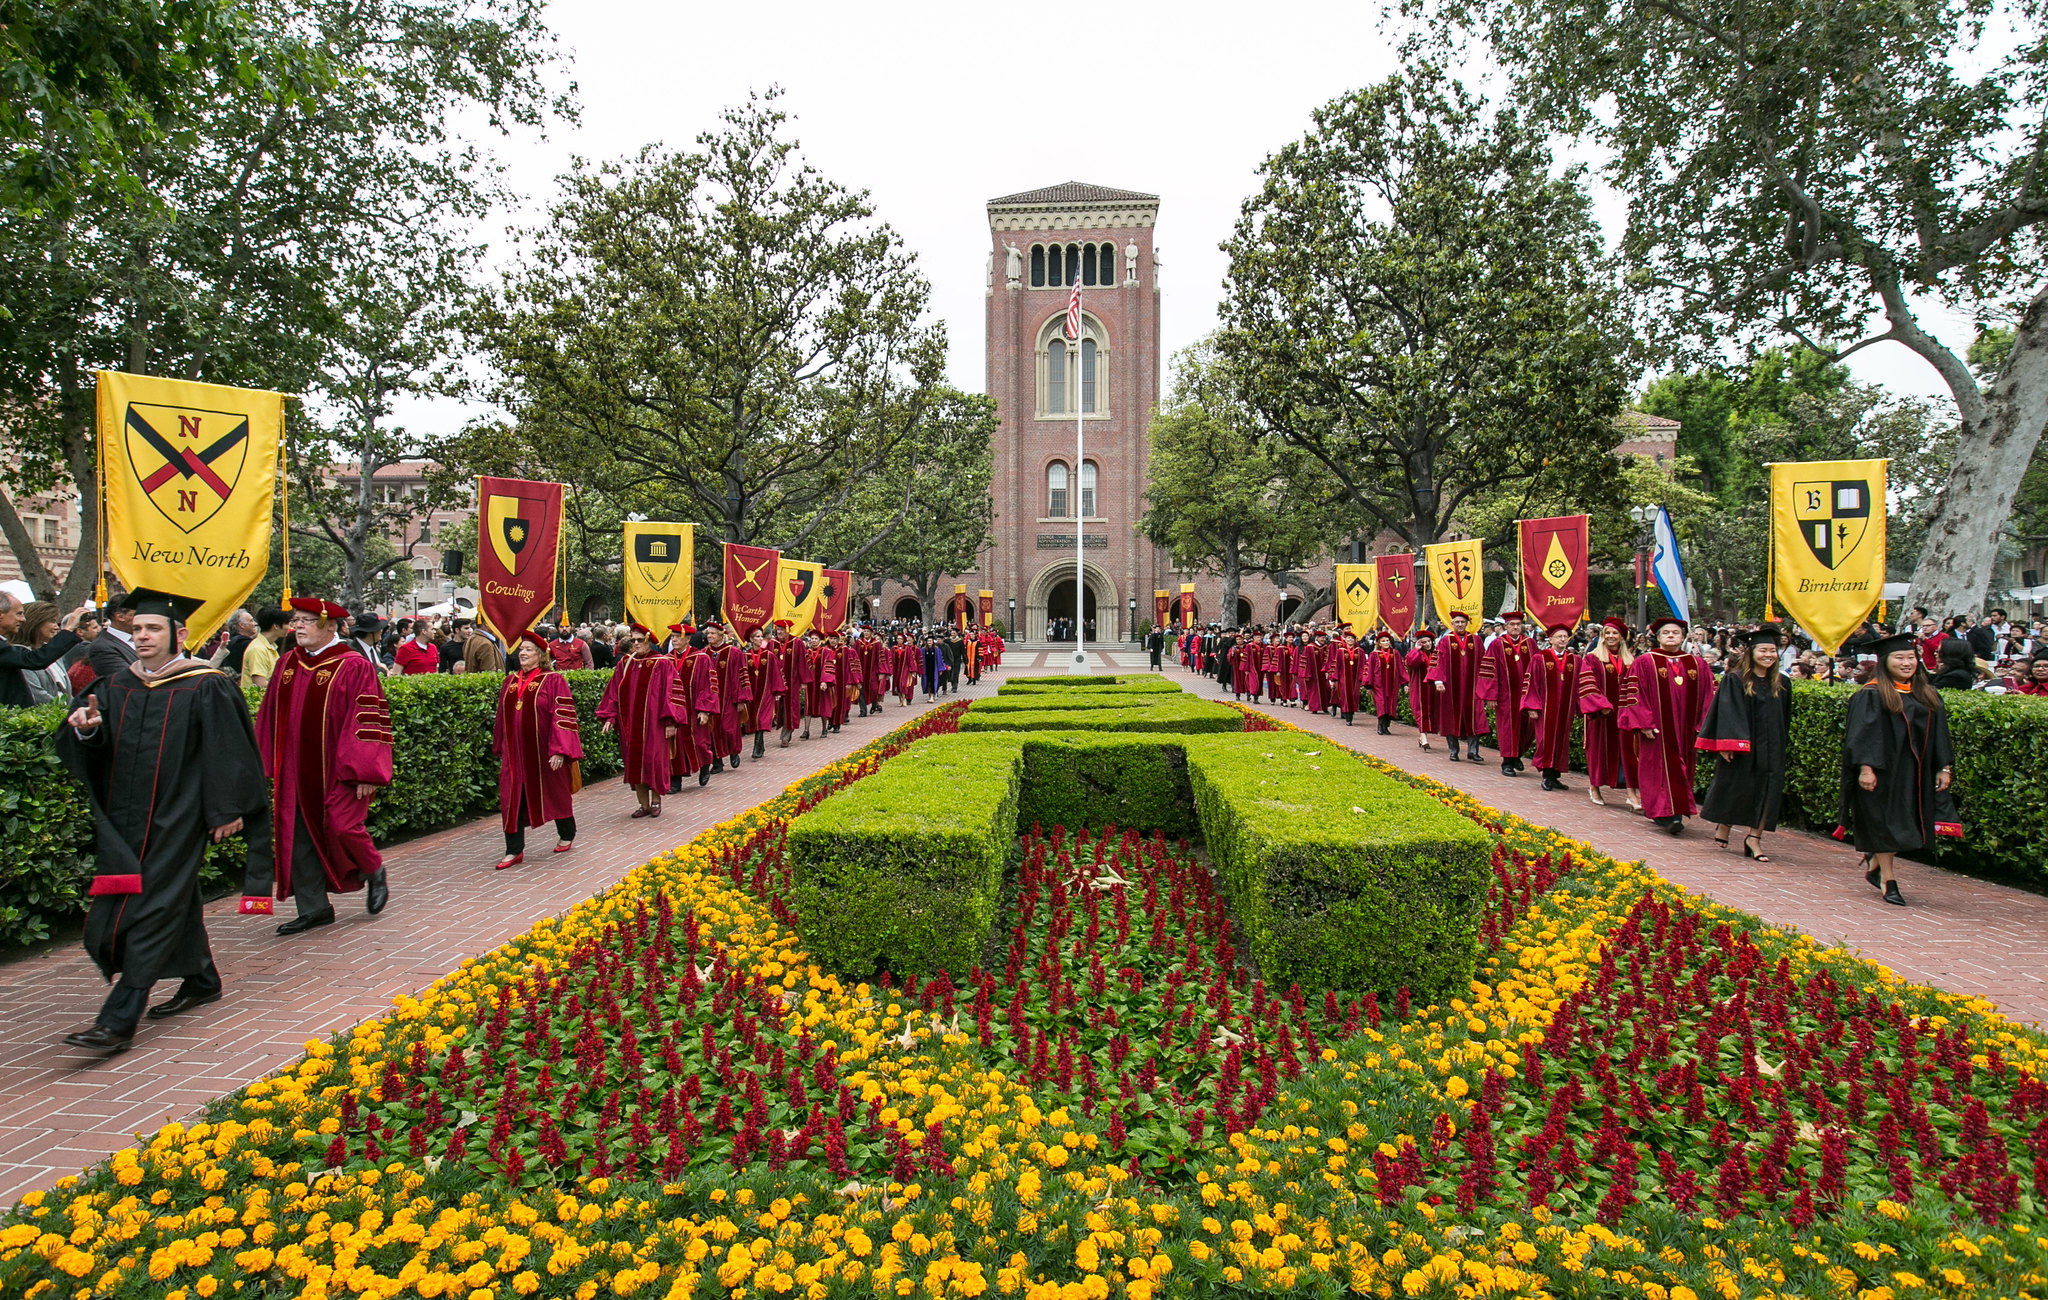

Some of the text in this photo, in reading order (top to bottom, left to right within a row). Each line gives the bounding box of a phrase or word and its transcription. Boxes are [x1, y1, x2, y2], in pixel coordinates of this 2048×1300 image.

[178, 415, 202, 438] N
[177, 490, 198, 513] N
[1805, 489, 1821, 512] B
[131, 541, 250, 569] New North
[485, 580, 536, 603] Cowlings
[1797, 578, 1869, 593] Birnkrant
[633, 595, 684, 609] Nemirovsky
[1450, 602, 1479, 611] Parkside
[1546, 595, 1575, 606] Priam
[731, 603, 766, 618] McCarthy
[1391, 605, 1409, 614] South
[734, 613, 760, 624] Honors
[252, 901, 269, 910] USC
